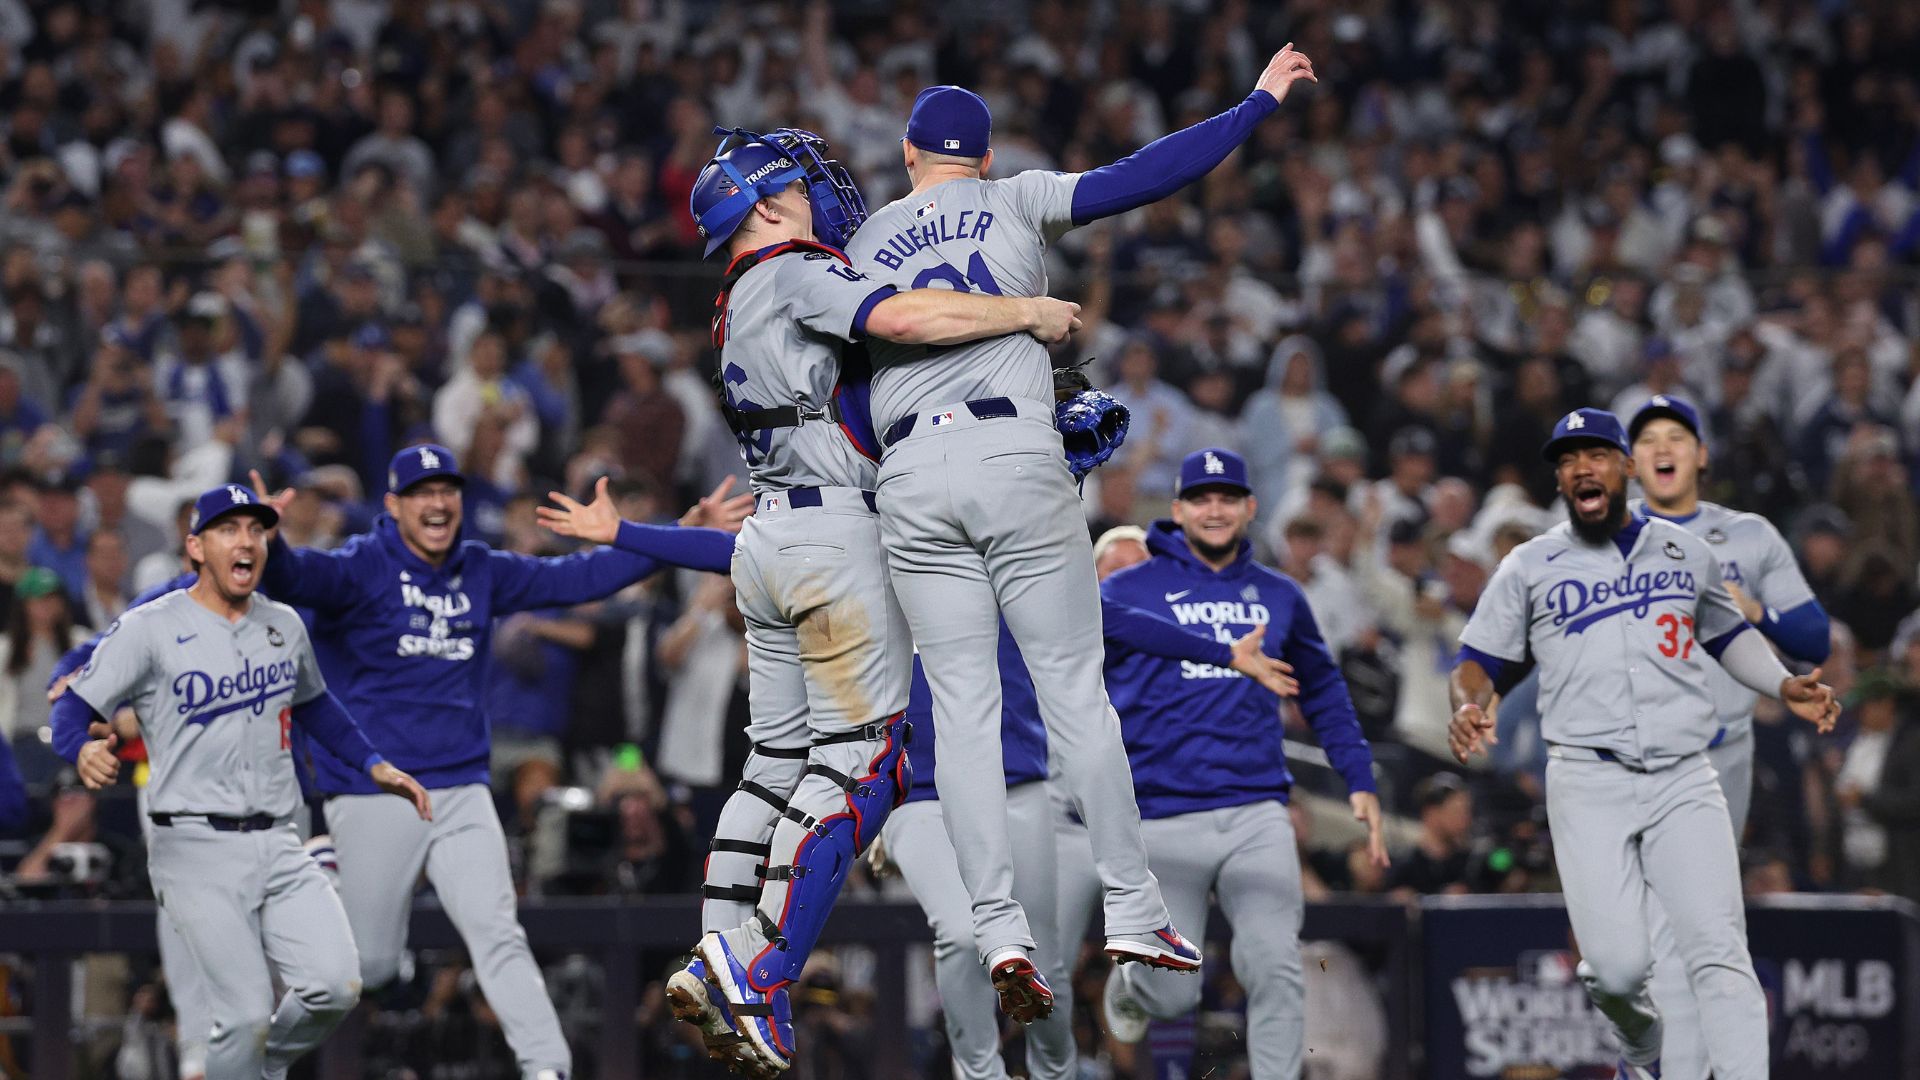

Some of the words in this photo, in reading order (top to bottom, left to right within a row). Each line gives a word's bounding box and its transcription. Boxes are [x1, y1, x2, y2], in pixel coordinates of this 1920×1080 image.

[744, 159, 779, 186] TRAUSS
[873, 209, 994, 272] BUEHLER
[1203, 451, 1225, 474] LA
[227, 485, 249, 505] LA
[1170, 601, 1270, 625] WORLD
[1547, 562, 1696, 627] Dodgers
[1655, 613, 1695, 660] 37
[173, 657, 297, 716] Dodgers
[1451, 976, 1592, 1024] WORL
[1783, 958, 1897, 1018] MLB
[1784, 1014, 1870, 1072] App
